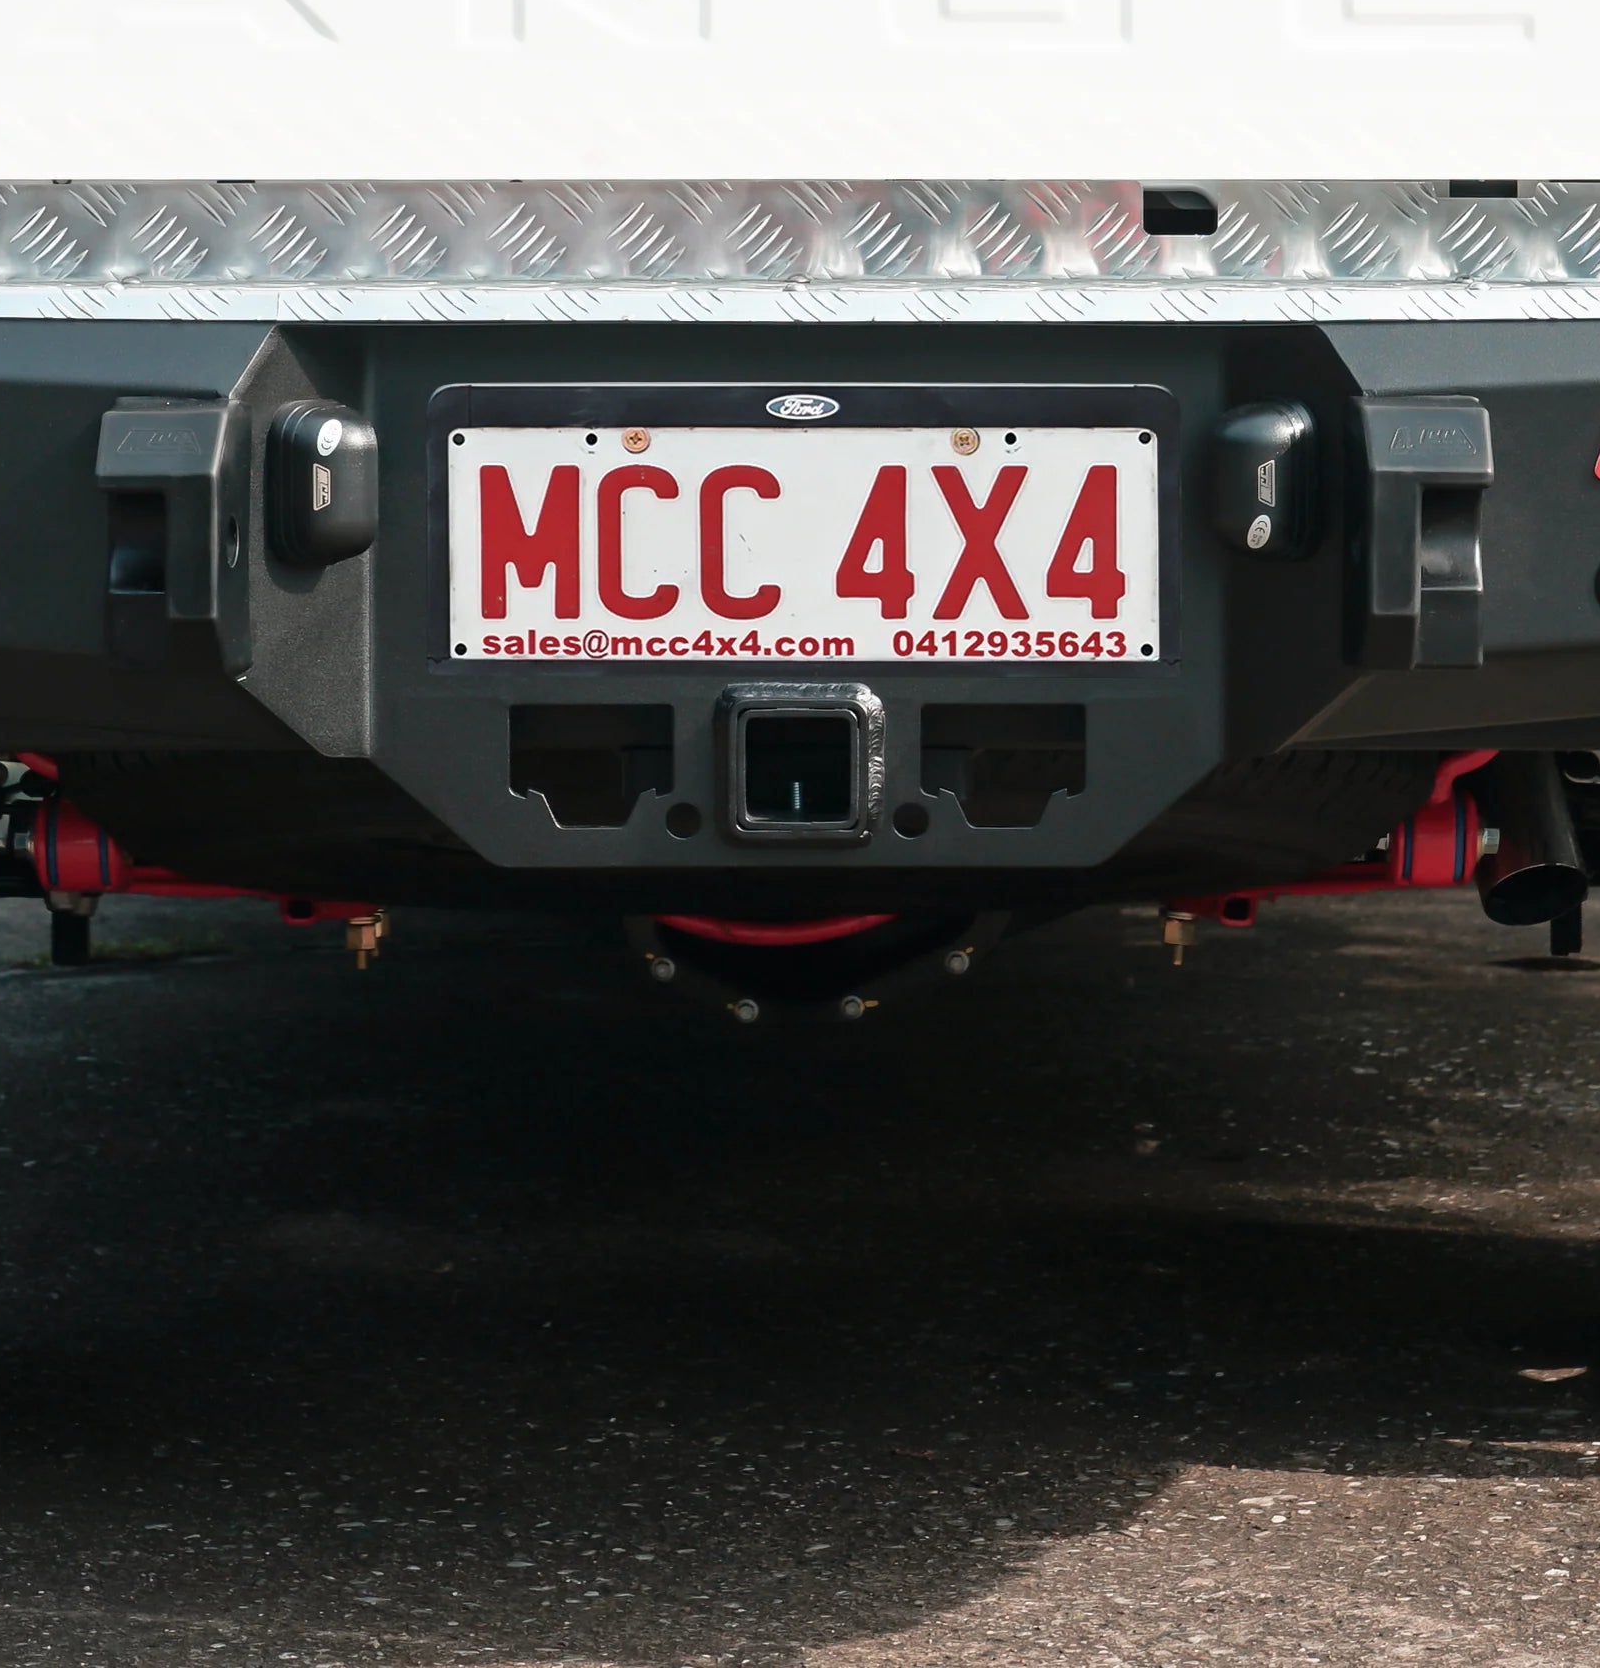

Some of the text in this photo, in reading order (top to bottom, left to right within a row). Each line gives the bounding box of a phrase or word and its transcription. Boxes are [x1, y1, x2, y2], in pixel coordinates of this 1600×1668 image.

[780, 398, 825, 415] Ford
[479, 464, 1128, 621] MCC 4X4
[482, 630, 1127, 658] sales@mcc4x4.com 0412935643
